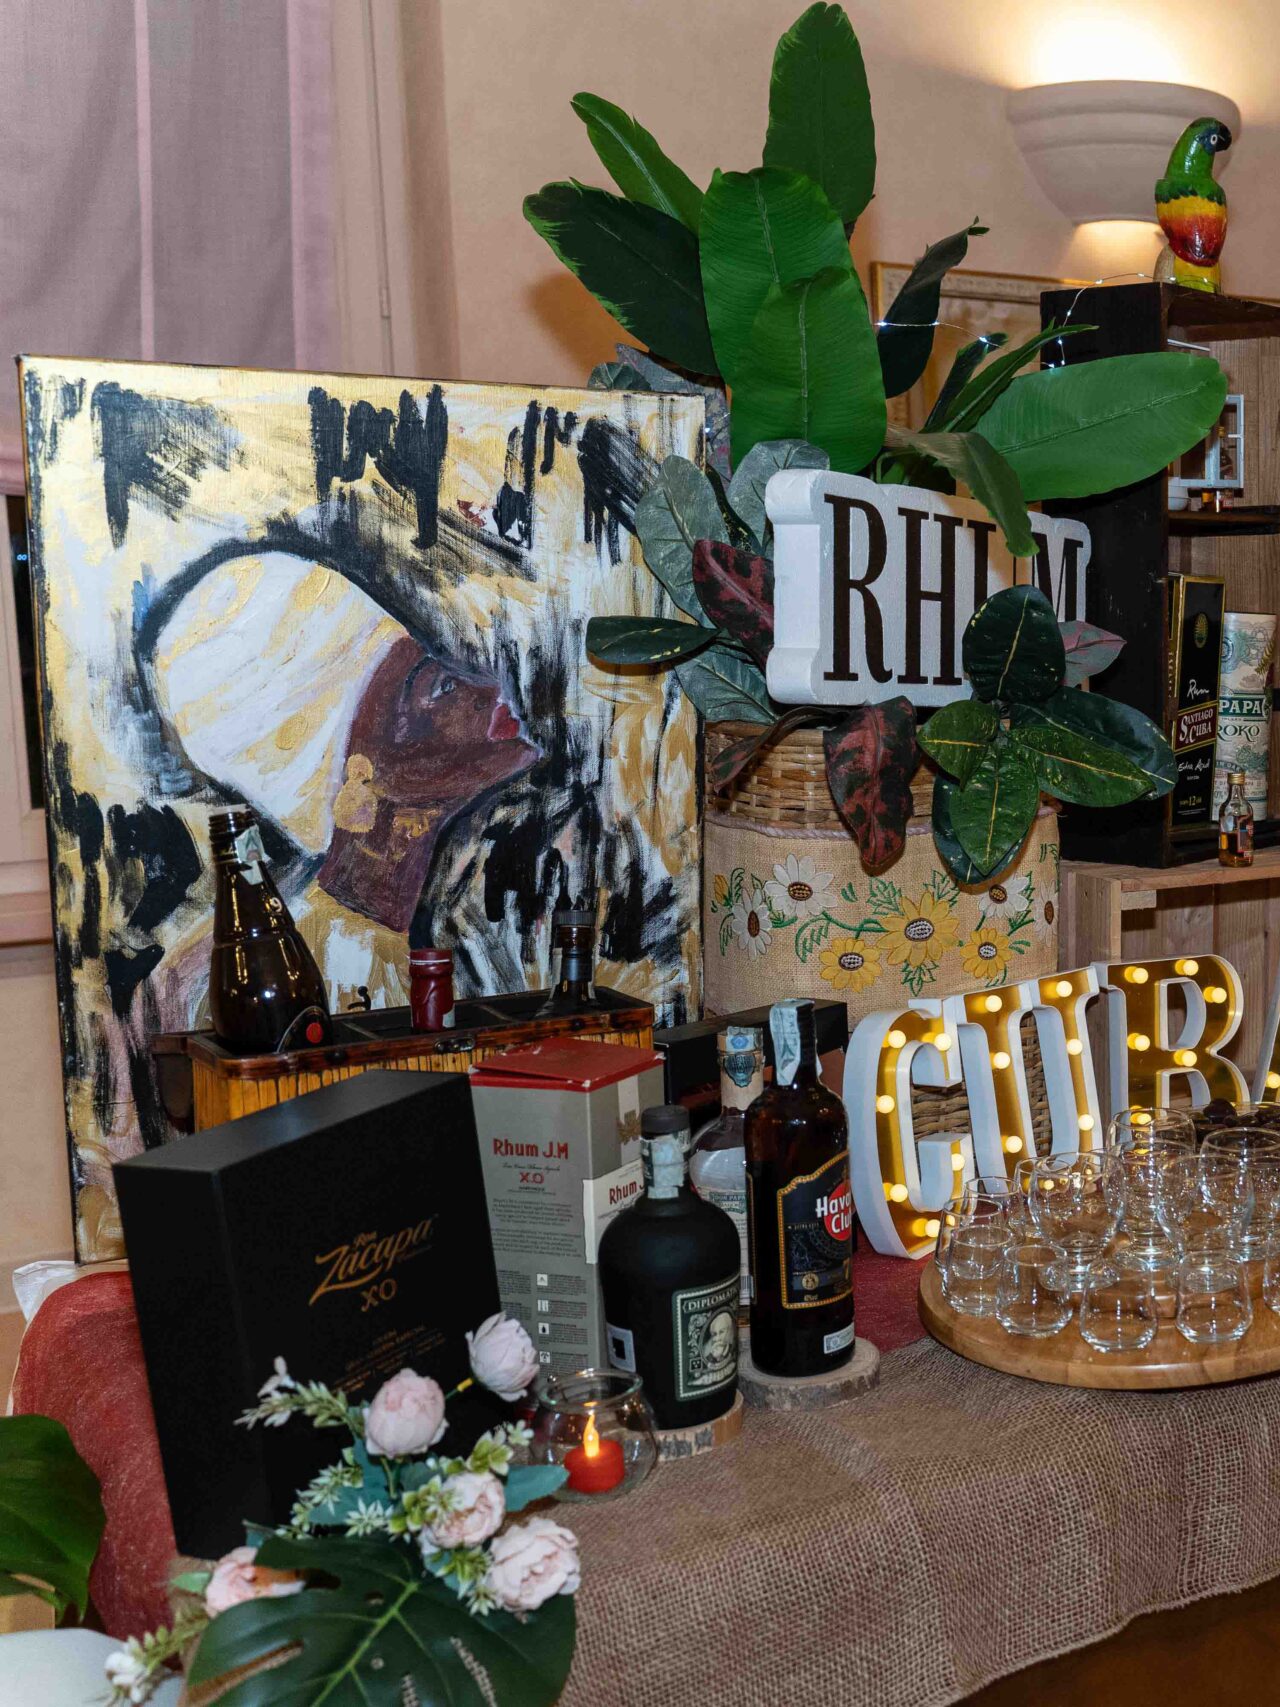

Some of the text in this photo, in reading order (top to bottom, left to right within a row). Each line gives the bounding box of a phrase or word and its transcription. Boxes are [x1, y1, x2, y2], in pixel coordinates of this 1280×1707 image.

[493, 1138, 539, 1159] Rhum
[609, 1181, 637, 1205] Rhum
[308, 1219, 433, 1306] Zacapa
[361, 1278, 398, 1312] XO
